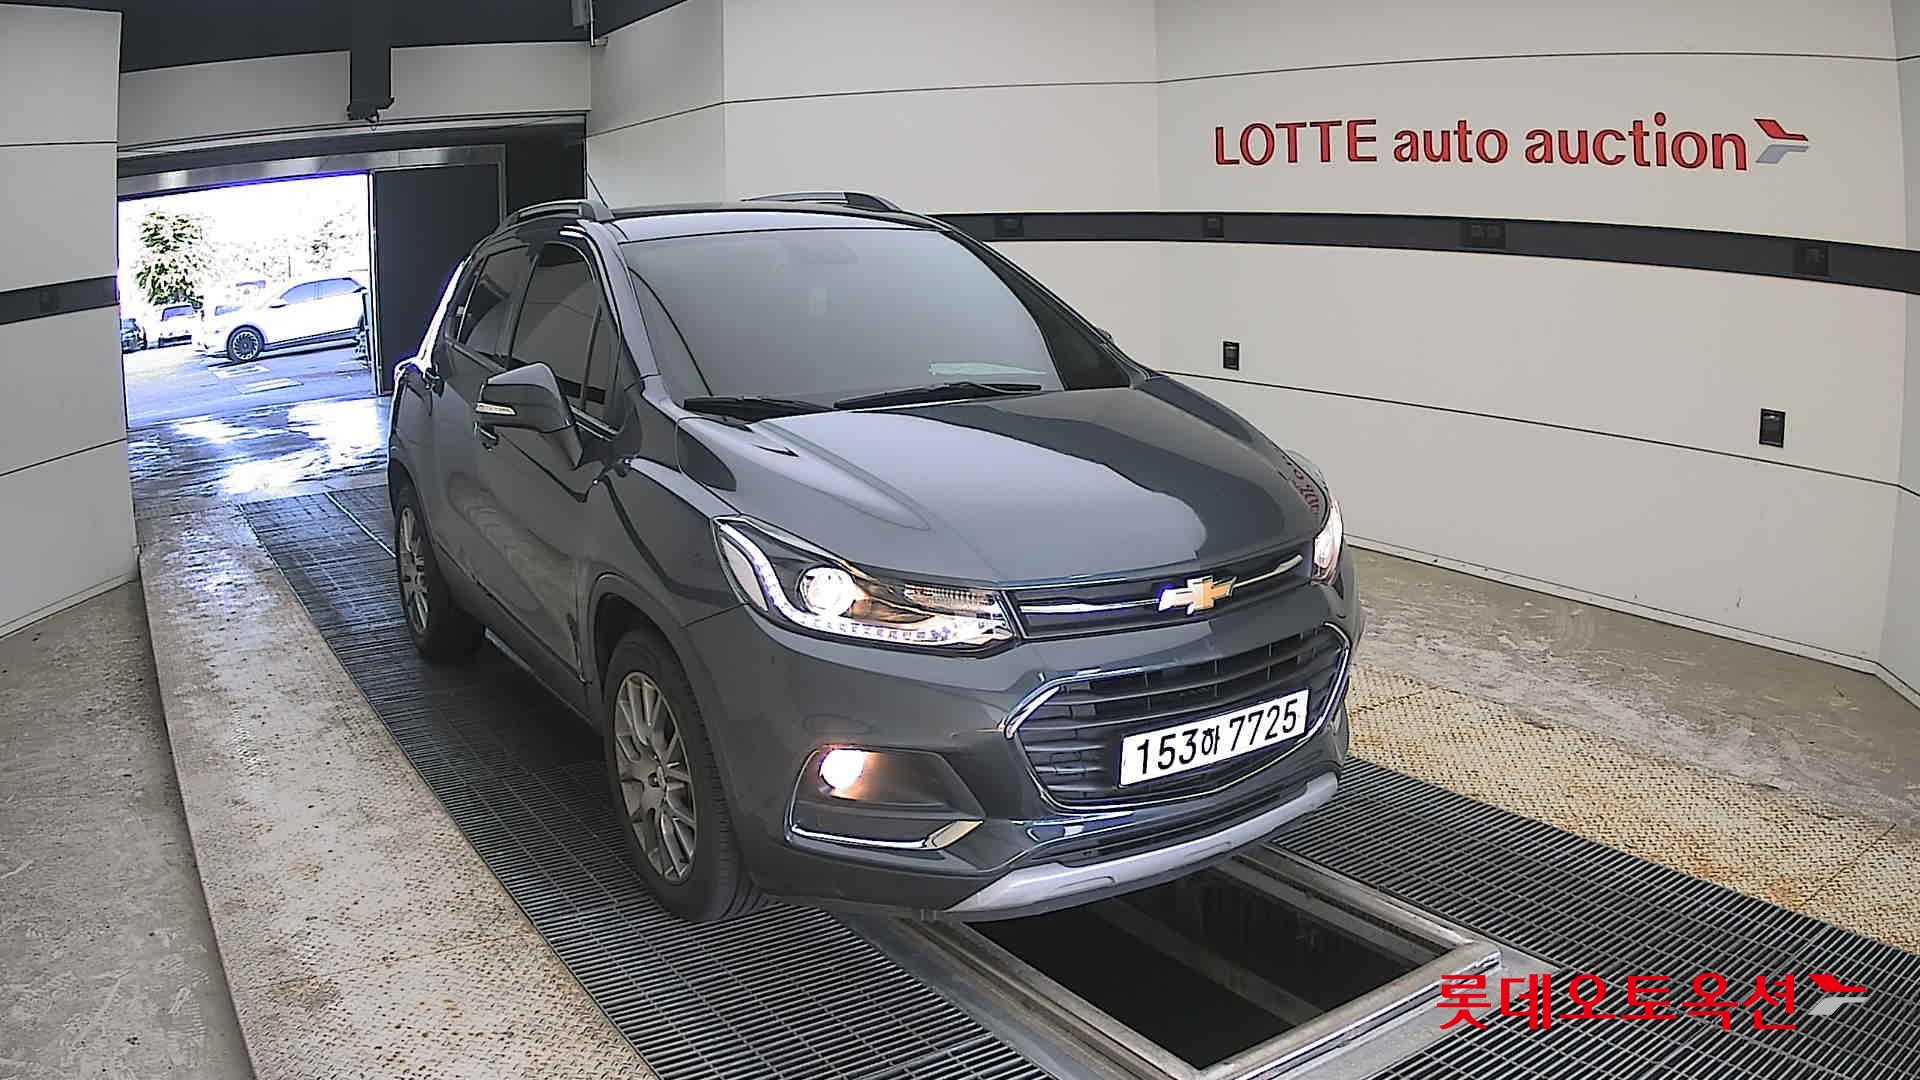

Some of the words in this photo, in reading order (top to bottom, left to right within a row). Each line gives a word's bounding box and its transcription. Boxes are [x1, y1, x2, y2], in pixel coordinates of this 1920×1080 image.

[1215, 119, 1377, 165] LOTTE
[1392, 120, 1507, 163] auto
[1525, 112, 1747, 171] auction
[1136, 725, 1220, 775] 153하
[1229, 698, 1298, 752] 7725
